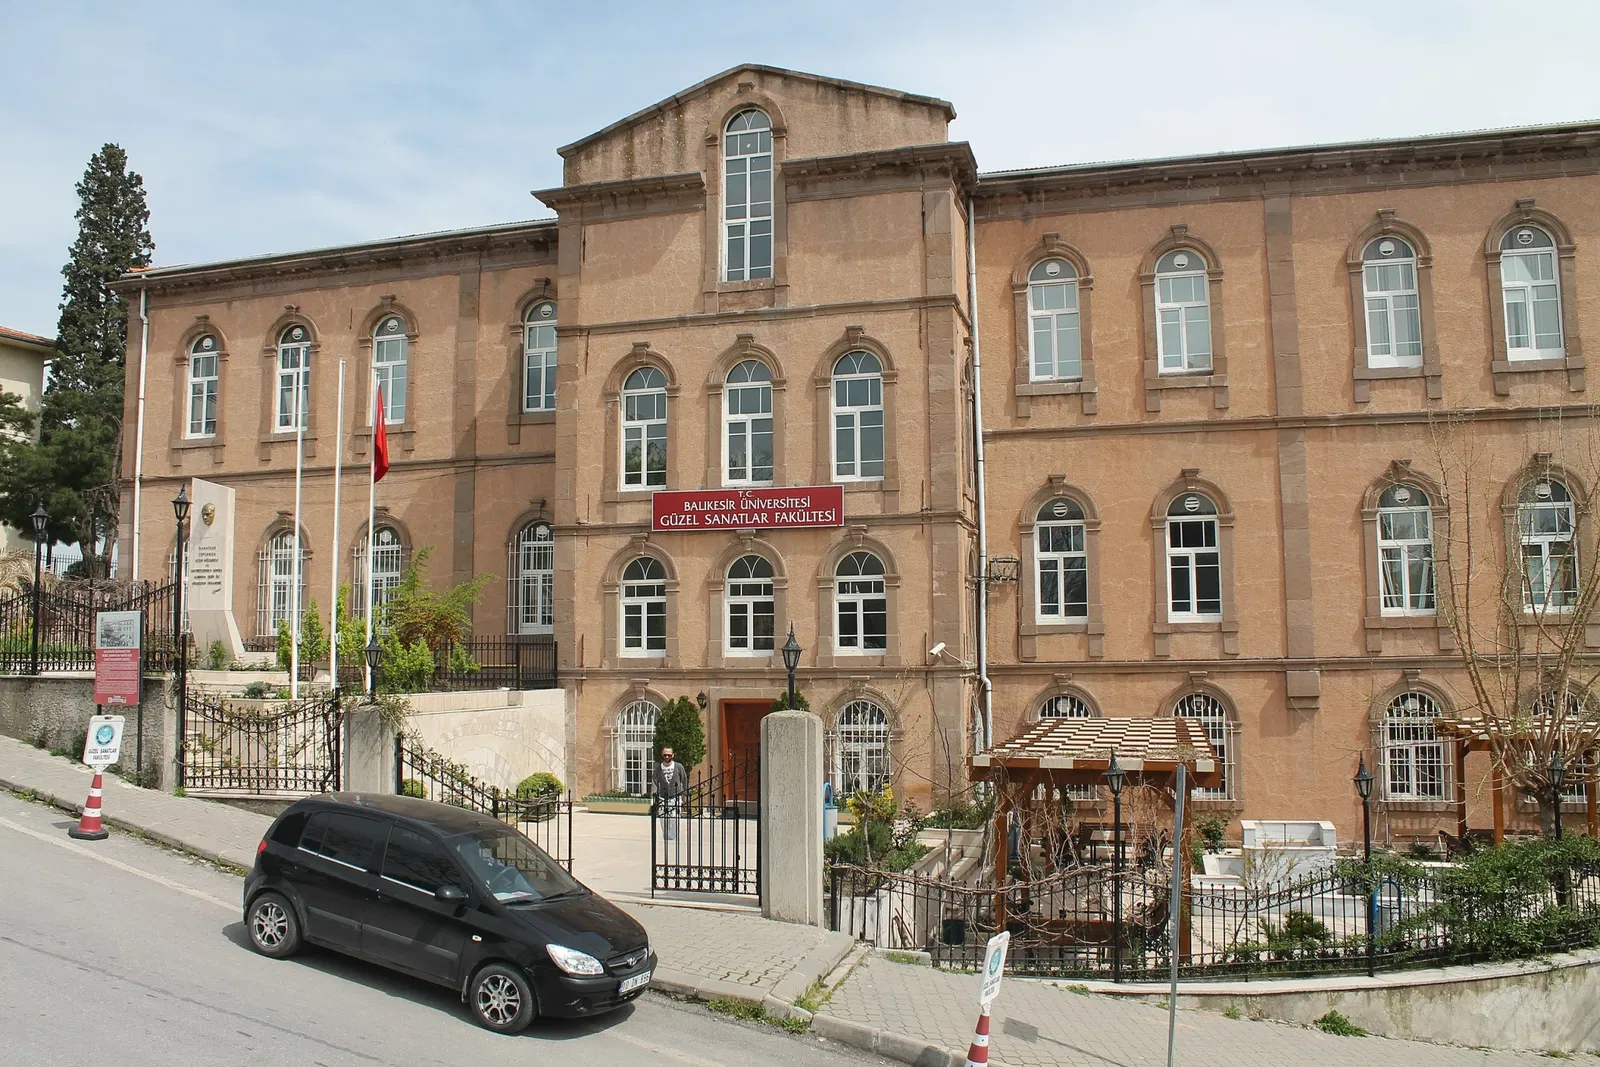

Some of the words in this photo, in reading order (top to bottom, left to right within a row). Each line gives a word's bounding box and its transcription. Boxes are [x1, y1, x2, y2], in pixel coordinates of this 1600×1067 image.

[684, 498, 736, 512] BALIKESİR
[740, 496, 811, 510] ÜNİVERSİTESİ
[660, 512, 700, 526] GÜZEL
[704, 512, 769, 525] SANATLAR
[774, 508, 836, 523] FAKÜLTESİ
